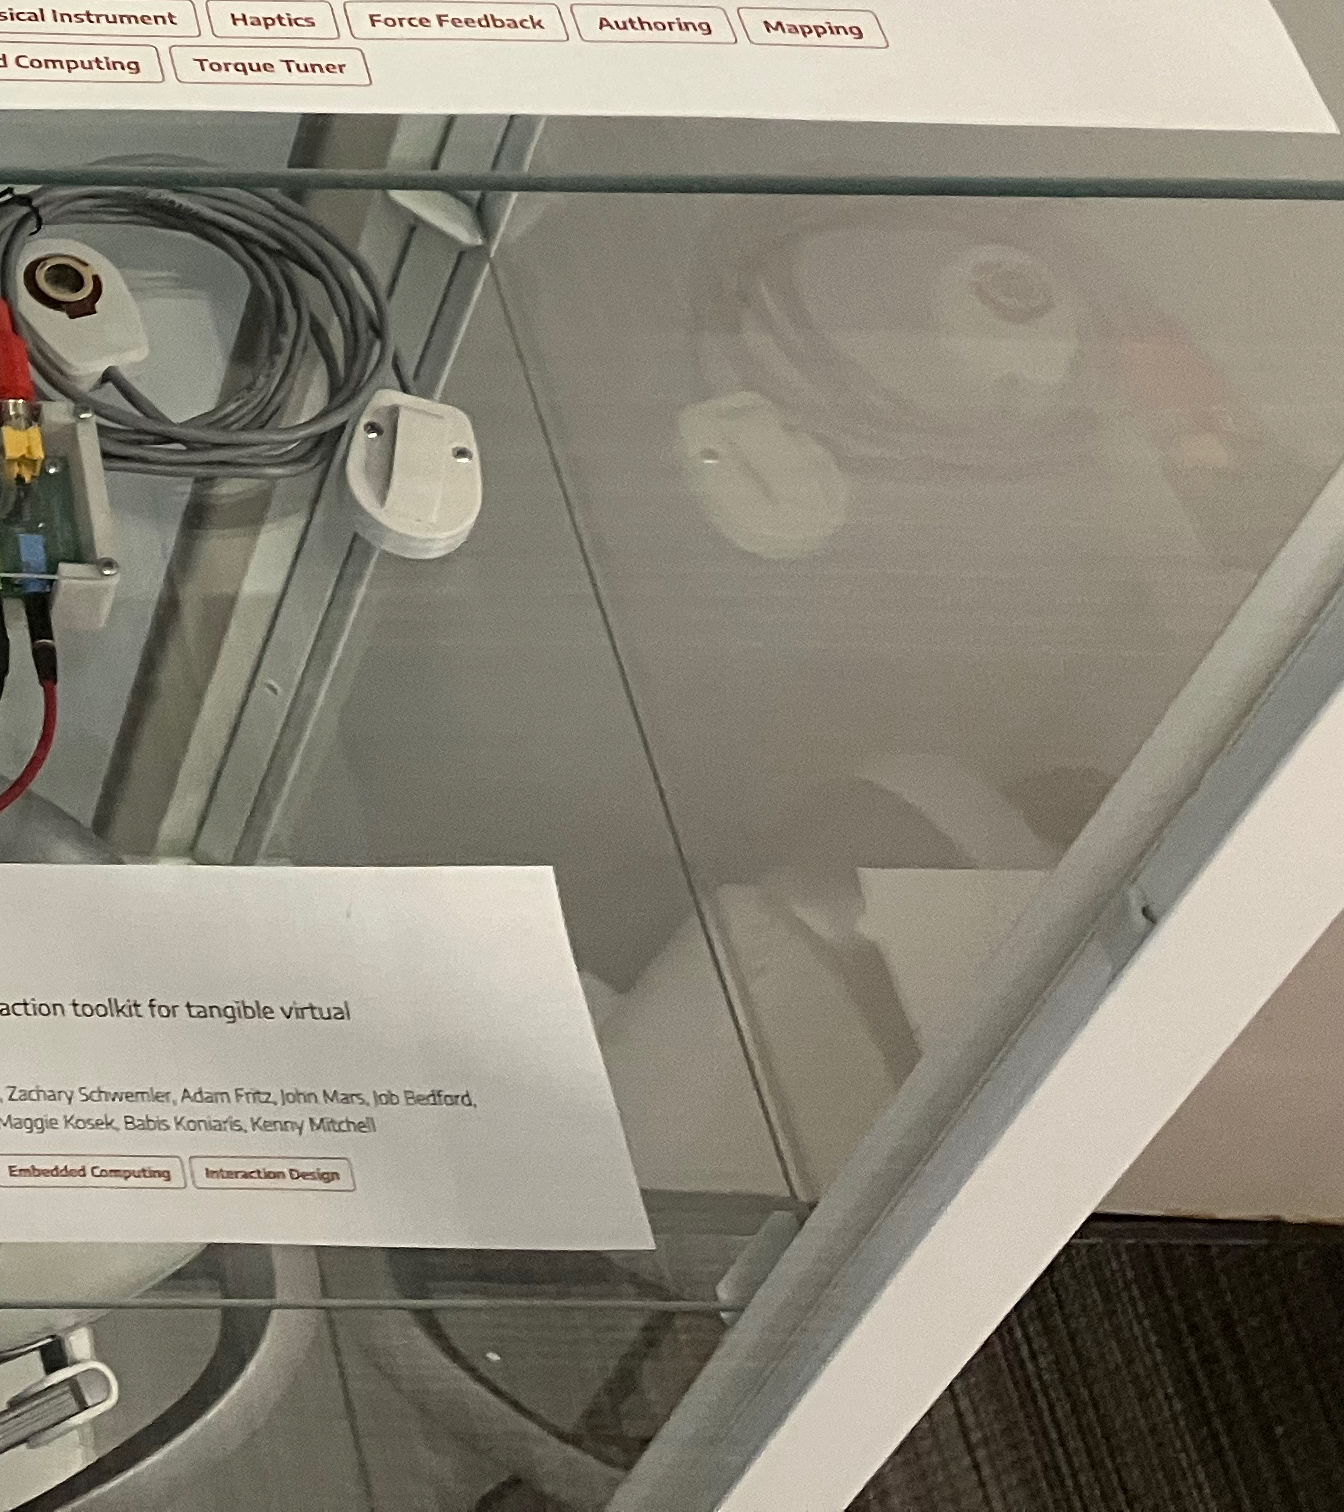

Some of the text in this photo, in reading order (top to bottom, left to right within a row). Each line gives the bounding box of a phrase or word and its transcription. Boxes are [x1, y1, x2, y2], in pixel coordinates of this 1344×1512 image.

[51, 8, 177, 26] Instrument
[230, 11, 316, 31] Haptics
[368, 13, 546, 31] Force Feedback
[598, 17, 713, 36] Authoring
[763, 20, 864, 39] Mapping
[15, 54, 141, 75] Computing
[193, 58, 346, 76] Torque Tuner
[72, 998, 142, 1018] toolkit
[148, 999, 179, 1019] for
[185, 1000, 275, 1024] tangible
[280, 1001, 350, 1021] virtual
[181, 1087, 477, 1109] Adam John Mars, Job Bedford,
[124, 1115, 170, 1132] Babis
[175, 1117, 247, 1134] Koniaris,
[251, 1117, 304, 1136] Kenny
[309, 1118, 376, 1134] Mitchell
[8, 1165, 171, 1182] Embedded Computing
[205, 1167, 340, 1183] Interaction Design
